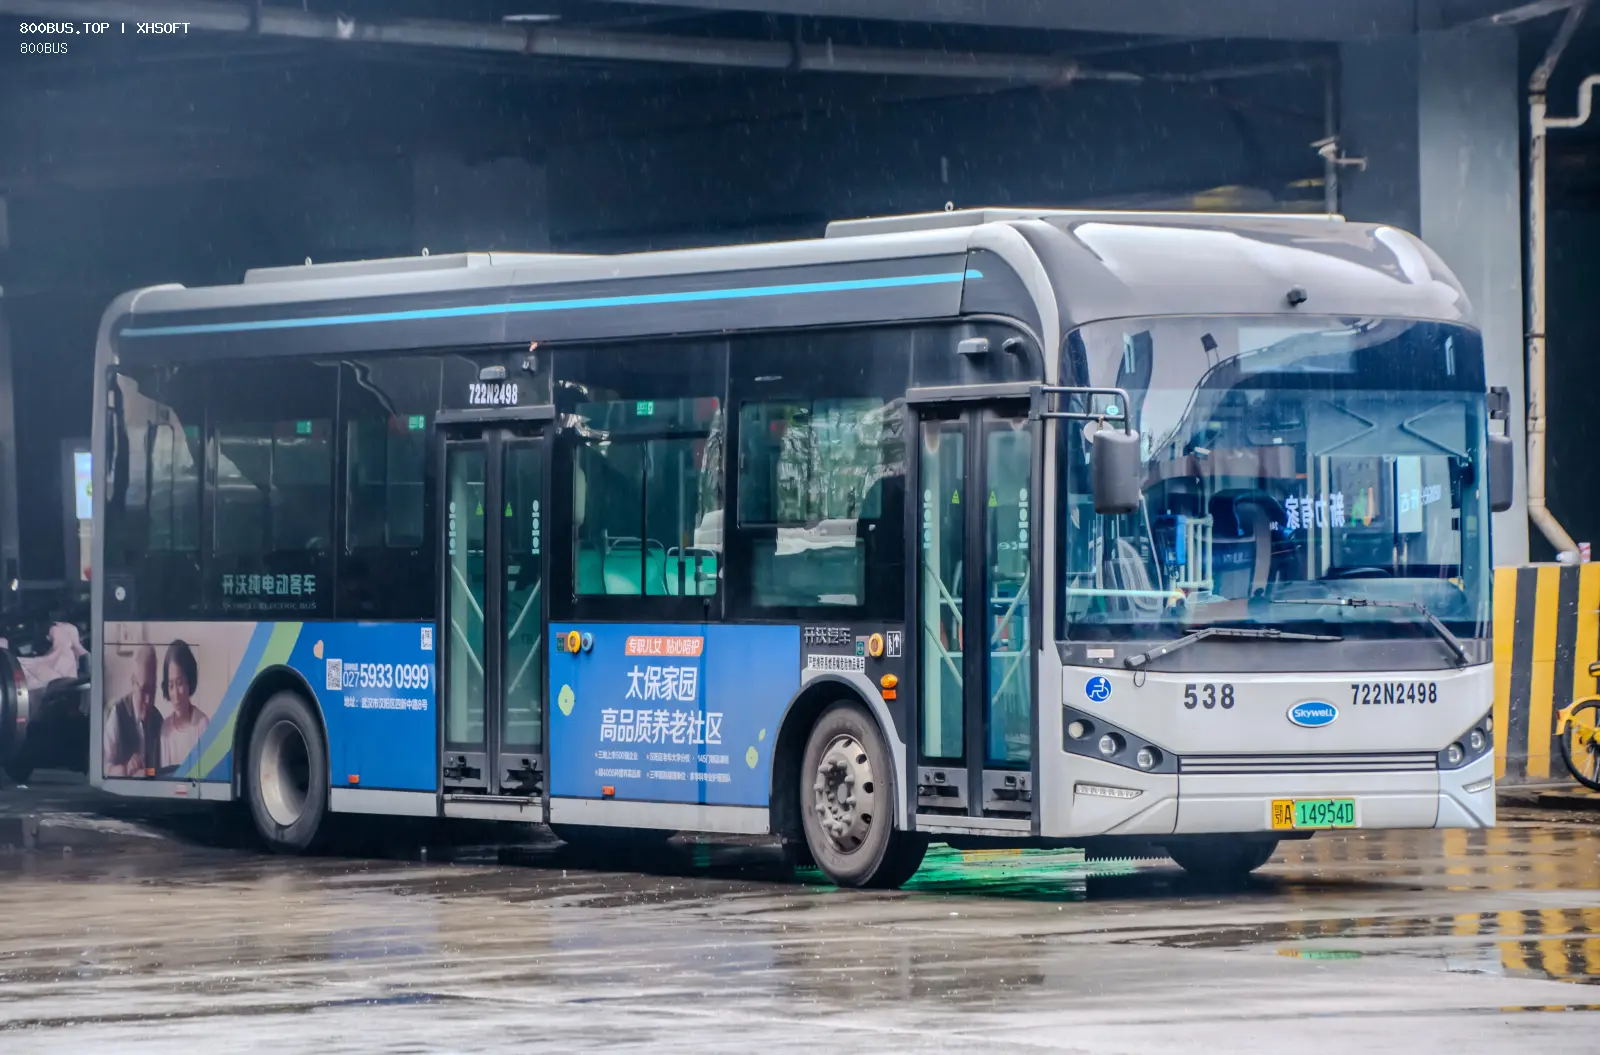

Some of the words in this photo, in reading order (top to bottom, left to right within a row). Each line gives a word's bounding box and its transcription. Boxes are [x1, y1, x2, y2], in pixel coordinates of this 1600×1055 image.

[469, 383, 518, 405] 722N2498
[222, 574, 317, 595] 开沃纯电动客车
[629, 638, 662, 654] 专职儿女
[804, 627, 851, 644] 开沃汽车
[344, 671, 359, 687] 027
[360, 663, 393, 689] 5933
[395, 664, 429, 690] 0999
[625, 665, 697, 700] 太保家园
[1184, 683, 1235, 709] 538
[1351, 682, 1438, 705] 722N2498
[600, 707, 723, 745] 高品质养老社区
[1301, 803, 1354, 824] 14954D
